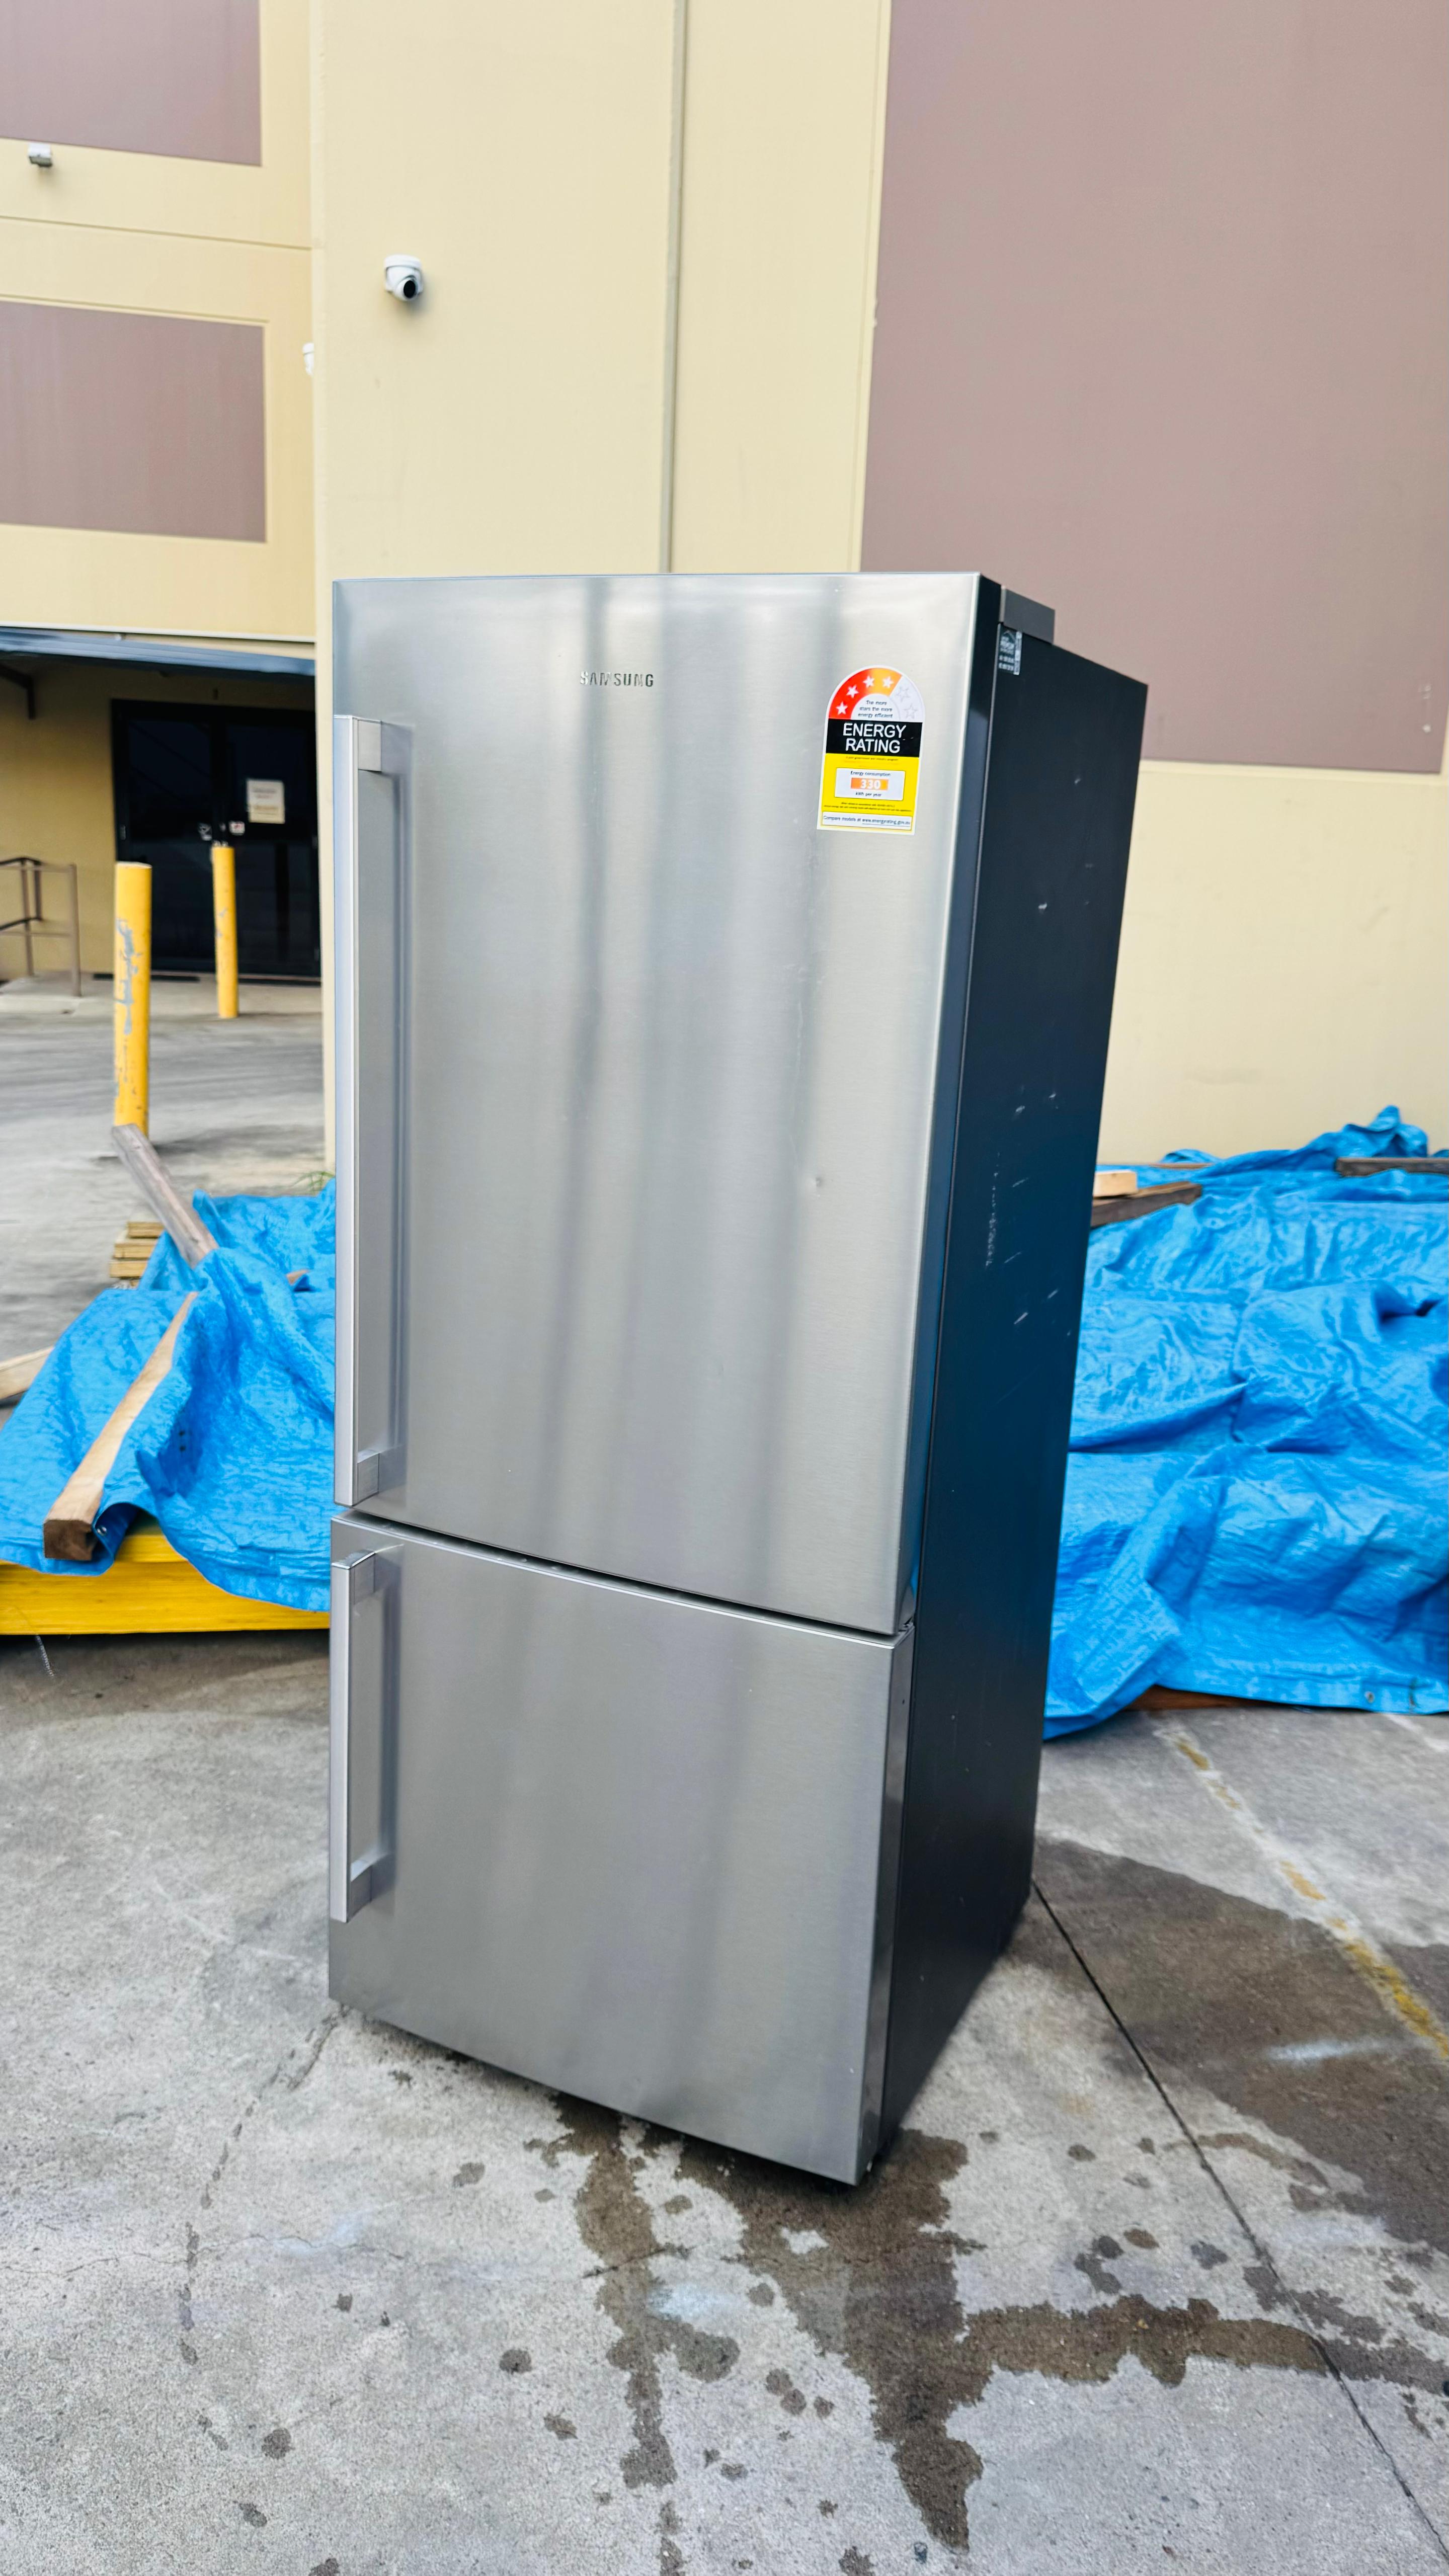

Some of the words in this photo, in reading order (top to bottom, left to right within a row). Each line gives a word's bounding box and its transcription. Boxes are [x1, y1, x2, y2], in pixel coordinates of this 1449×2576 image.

[580, 671, 654, 687] SAMSUNG
[843, 722, 907, 738] ENERGY
[845, 738, 901, 754] RATING
[860, 778, 881, 790] 330
